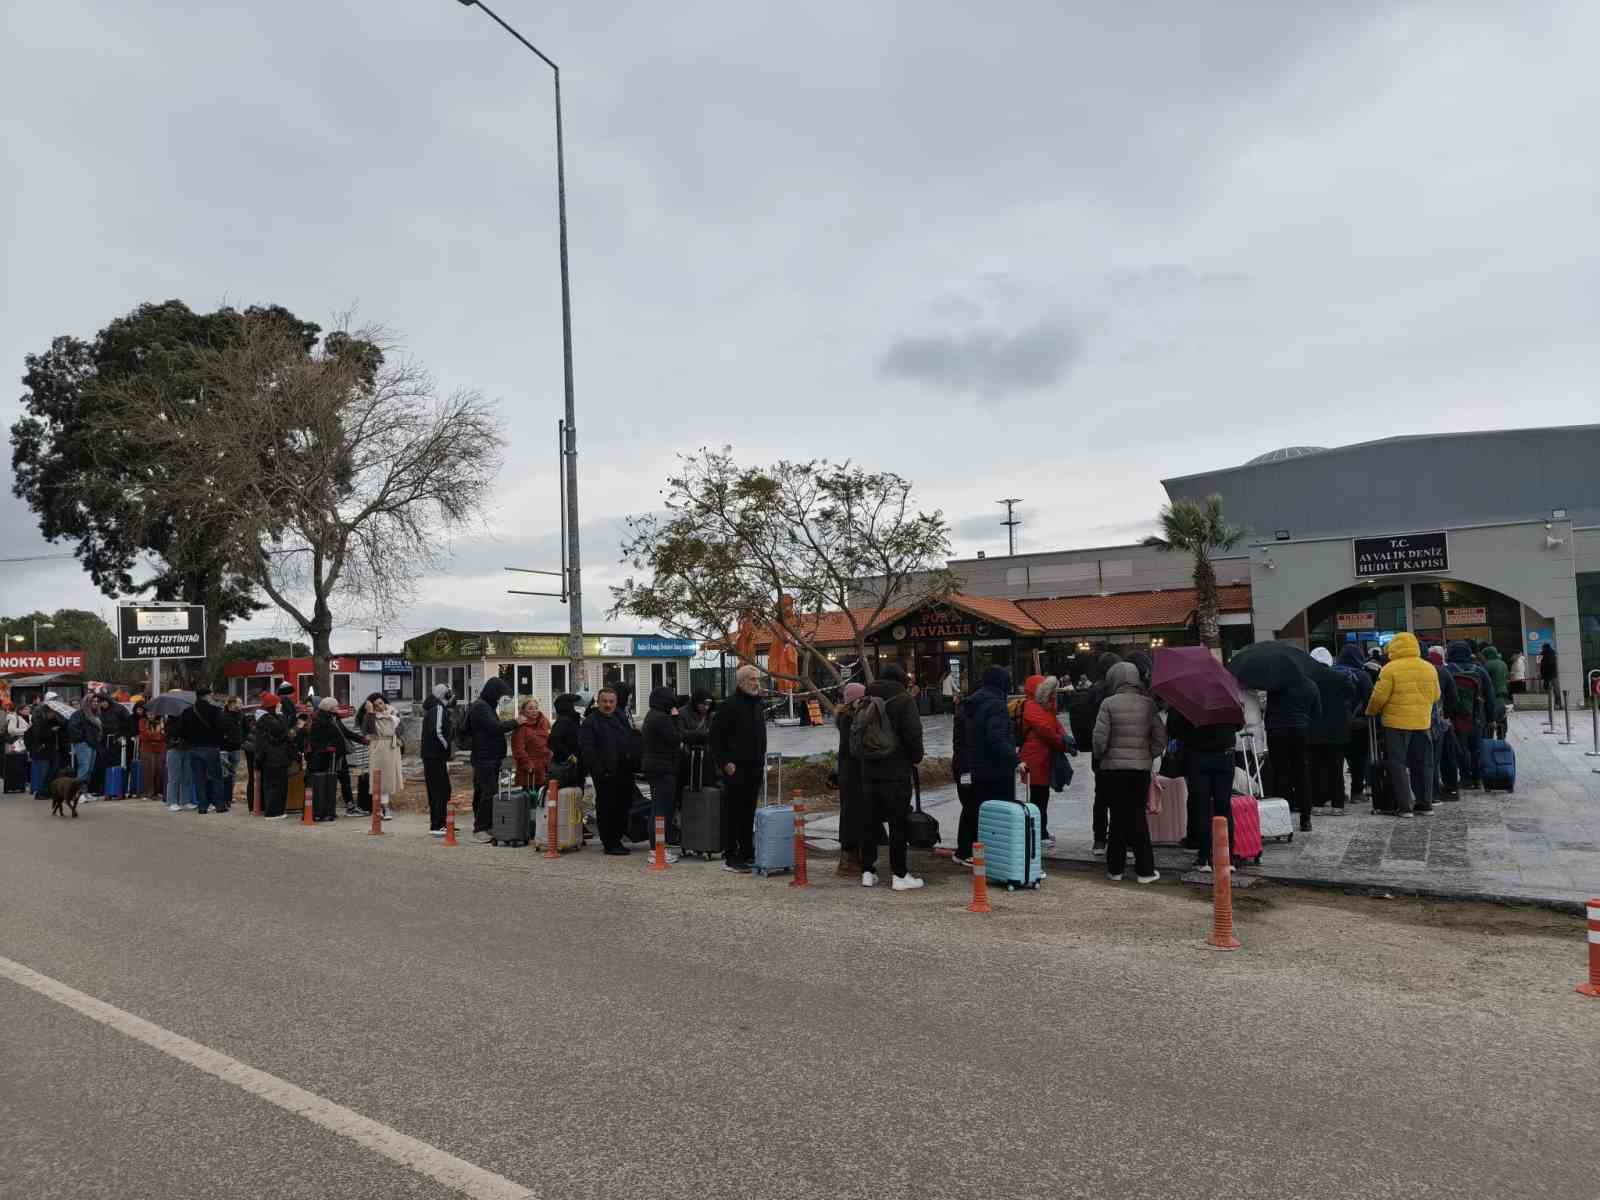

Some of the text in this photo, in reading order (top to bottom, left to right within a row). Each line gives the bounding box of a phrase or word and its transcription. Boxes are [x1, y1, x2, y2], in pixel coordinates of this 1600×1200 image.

[1391, 540, 1409, 548] T.C.
[1360, 546, 1442, 562] AYVALIK DENİZ
[1360, 559, 1444, 572] HUDUT KAPISI
[160, 646, 190, 654] NOKTASI
[0, 655, 81, 668] NOKTA BÜFE
